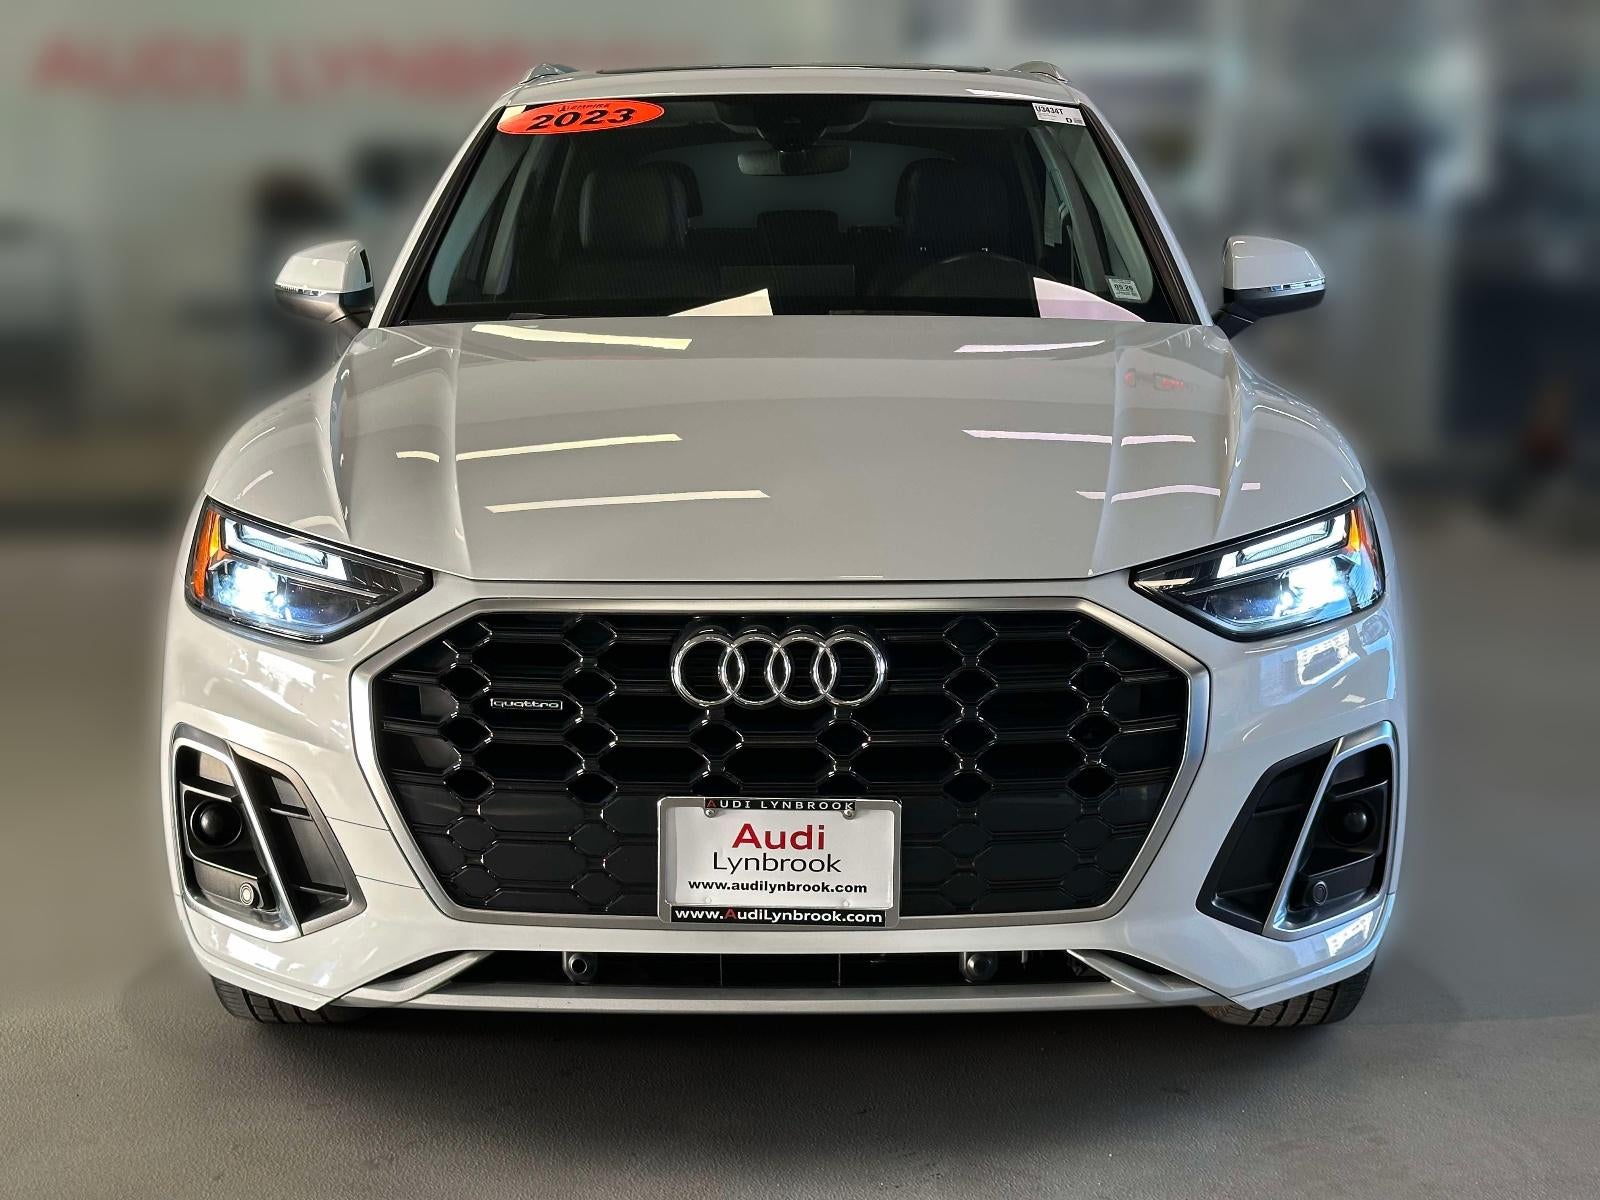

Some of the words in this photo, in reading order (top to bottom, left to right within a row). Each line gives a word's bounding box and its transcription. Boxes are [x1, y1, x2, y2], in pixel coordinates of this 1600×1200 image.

[526, 107, 636, 131] 2023
[493, 700, 560, 708] quattro
[706, 799, 751, 809] AUDI
[760, 800, 855, 811] LYNBROOK
[731, 823, 826, 850] Audi
[712, 851, 842, 875] Lynbrook
[687, 880, 868, 894] www.audilynbrook.com
[674, 906, 883, 924] www.AudiLynbrook.com
